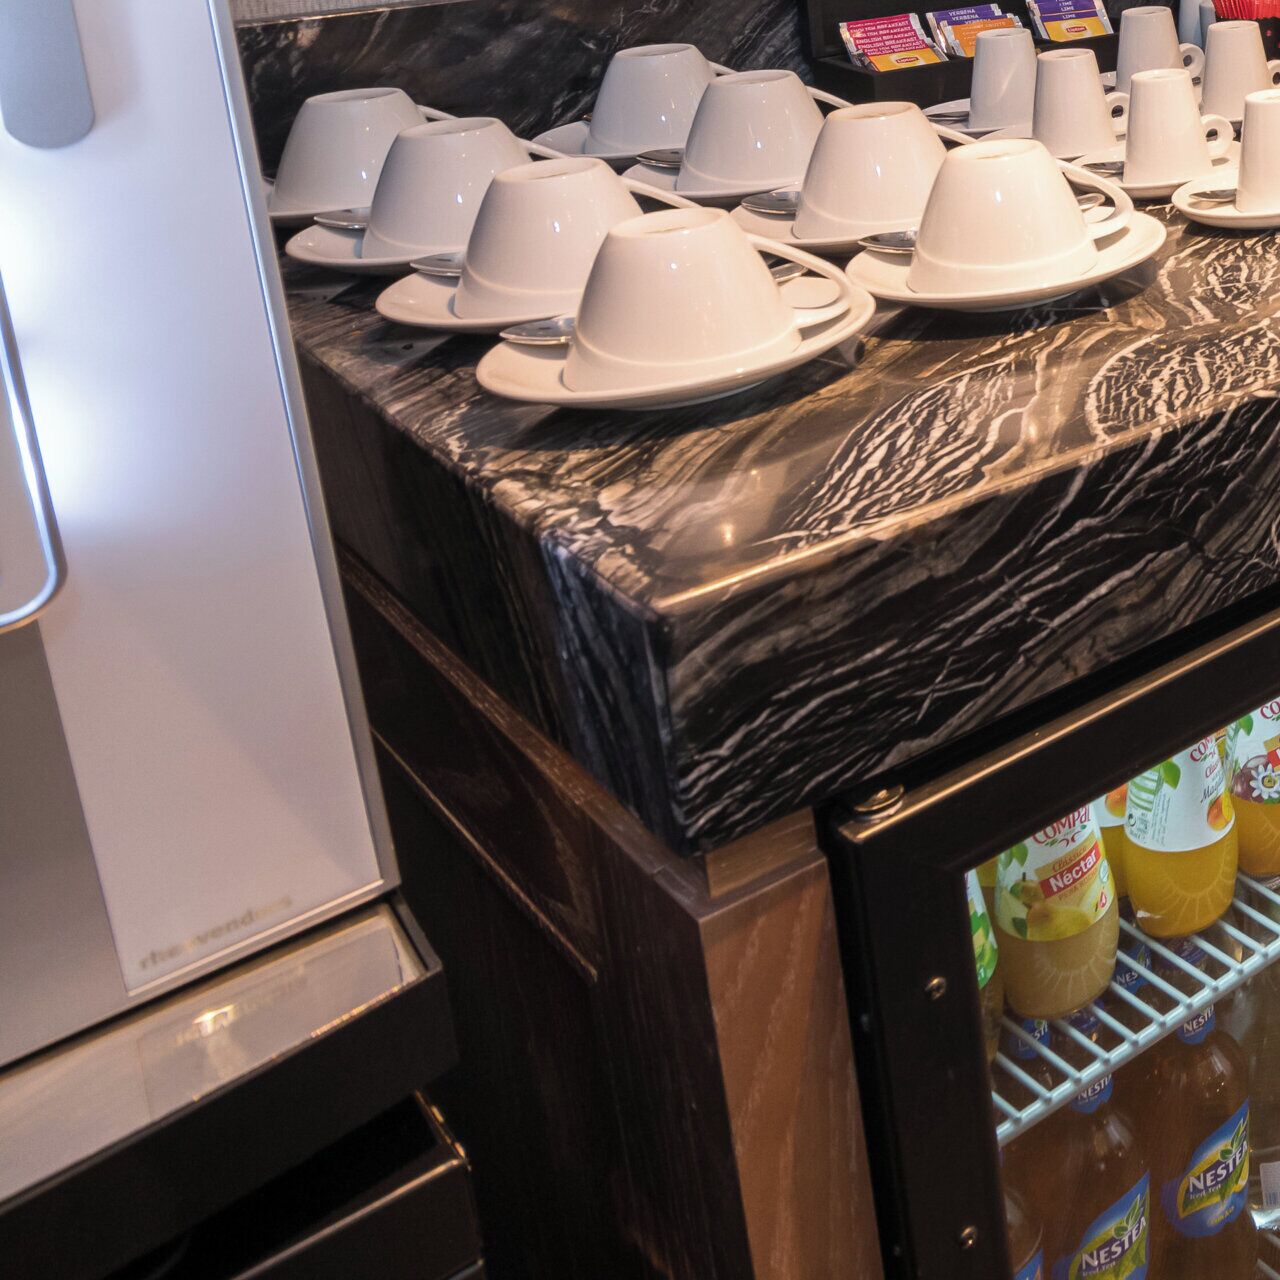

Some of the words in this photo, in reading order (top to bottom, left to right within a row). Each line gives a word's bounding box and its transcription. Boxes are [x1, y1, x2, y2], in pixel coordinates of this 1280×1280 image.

[949, 9, 976, 17] VERBENA
[856, 35, 882, 44] ENGLISH
[883, 31, 916, 41] BREAKFAST
[858, 41, 884, 50] ENGLISH
[885, 36, 918, 46] BREAKFAST
[1048, 848, 1097, 892] Néctar
[1188, 1140, 1248, 1193] NESTEA
[1081, 1216, 1147, 1270] NESTEA
